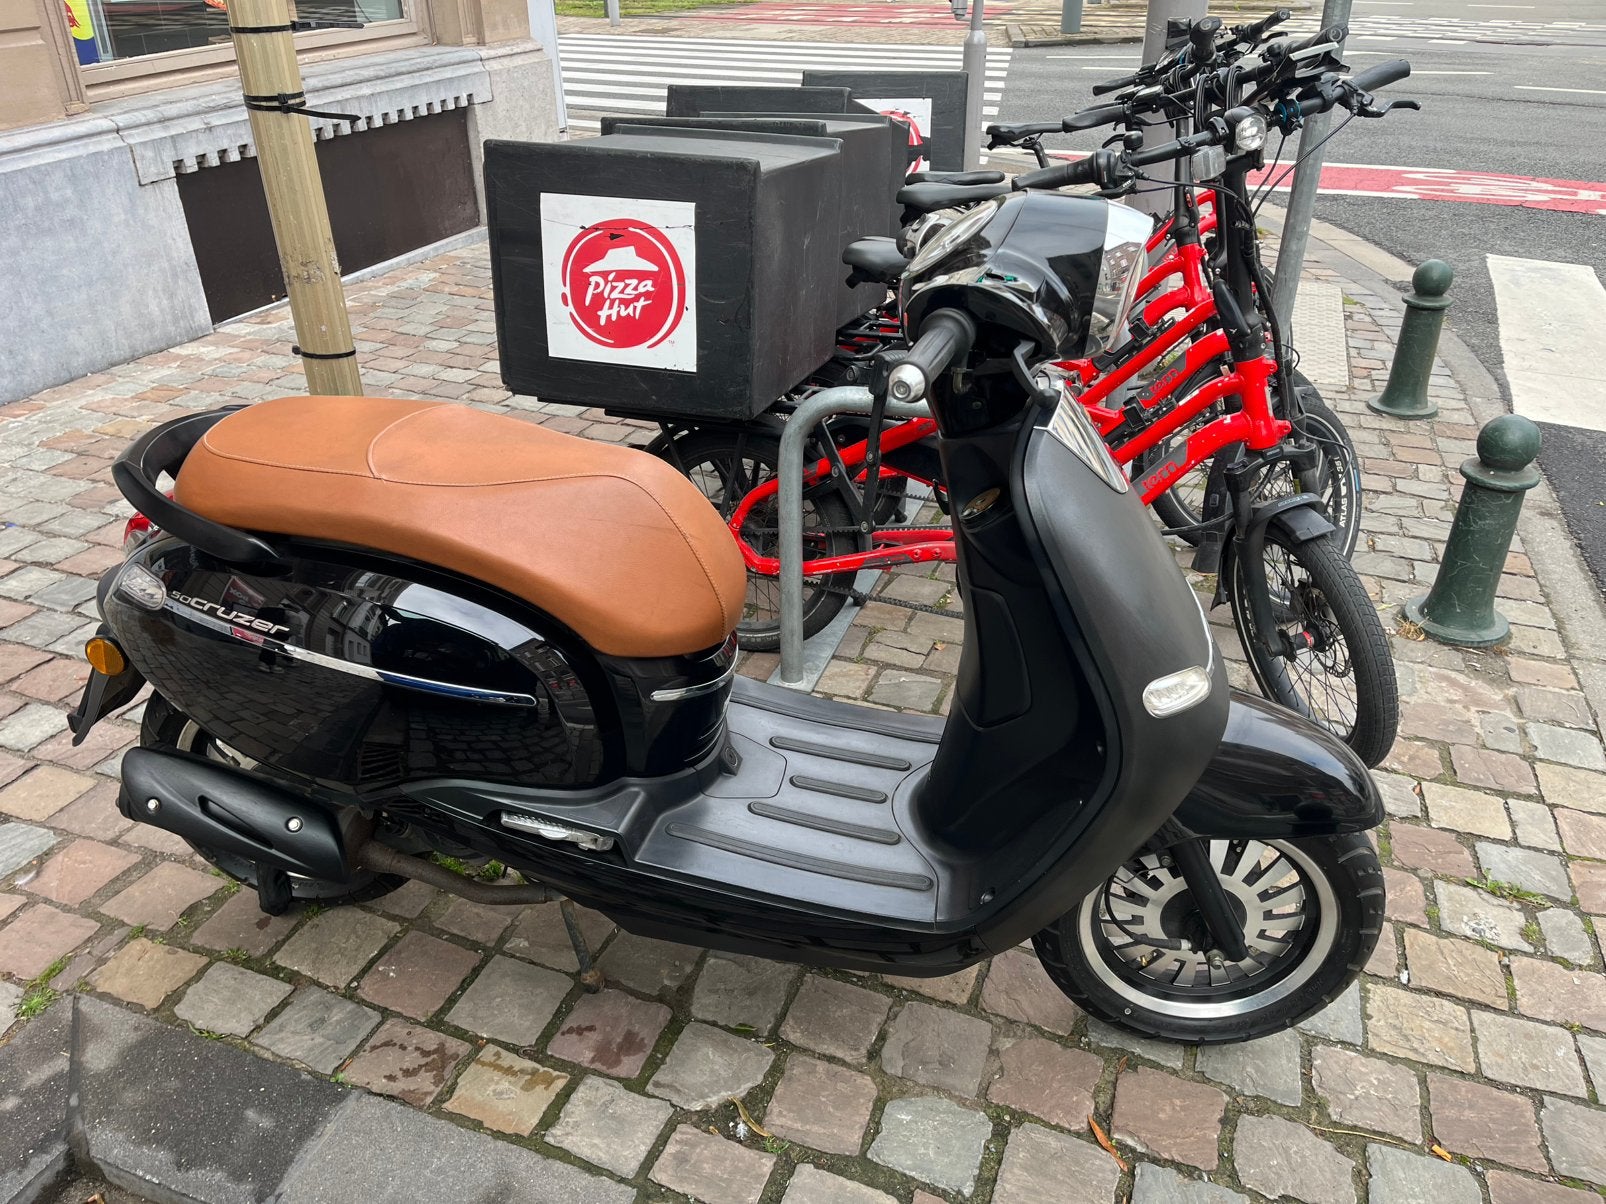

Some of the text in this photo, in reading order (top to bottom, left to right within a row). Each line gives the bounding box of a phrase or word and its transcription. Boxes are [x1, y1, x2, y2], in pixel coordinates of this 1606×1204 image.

[585, 271, 655, 307] Pizza
[596, 296, 653, 326] Hut
[1339, 497, 1348, 528] ATLAS
